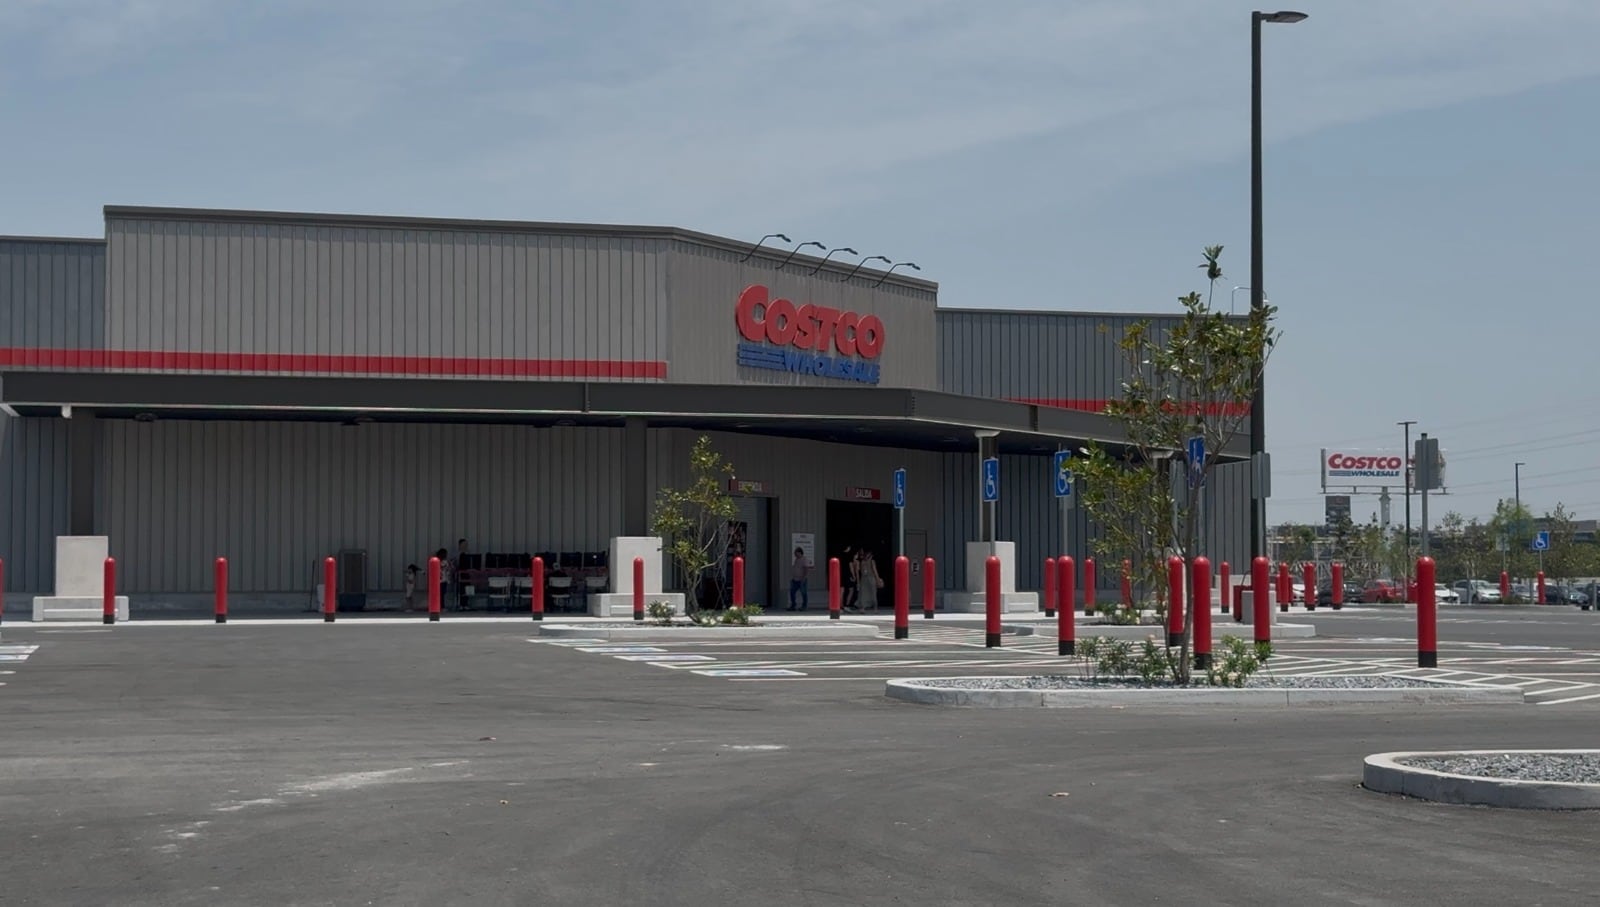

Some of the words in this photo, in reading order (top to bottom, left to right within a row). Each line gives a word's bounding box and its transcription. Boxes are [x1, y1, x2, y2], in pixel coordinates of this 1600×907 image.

[736, 284, 885, 359] COSTCO
[783, 350, 881, 385] WHOLESALE
[1328, 453, 1402, 469] COSTCO
